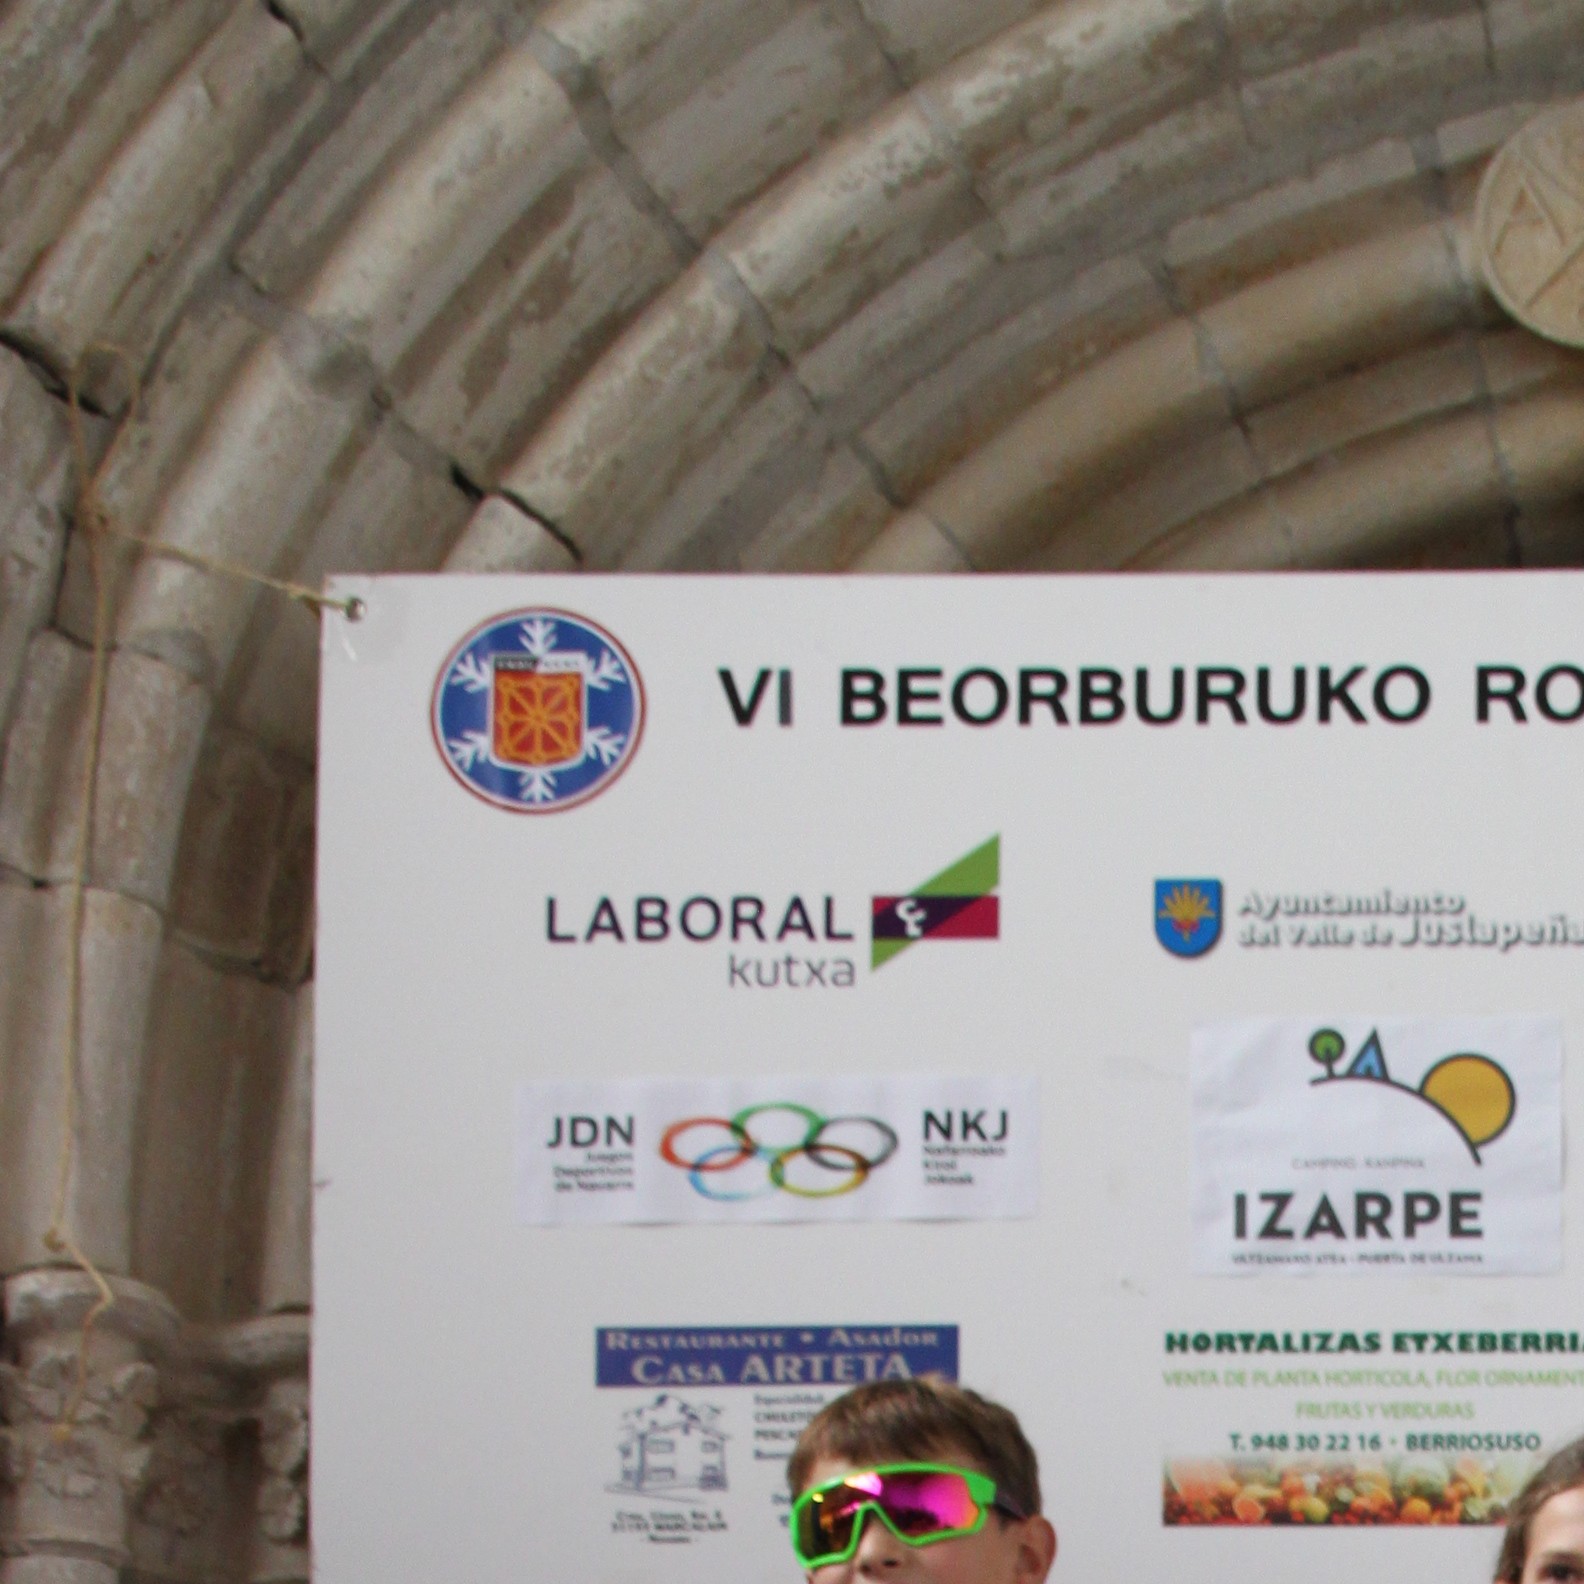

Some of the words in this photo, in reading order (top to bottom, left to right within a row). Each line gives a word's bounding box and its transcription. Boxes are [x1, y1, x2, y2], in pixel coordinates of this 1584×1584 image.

[718, 668, 794, 727] VI
[840, 666, 1432, 727] BEORBURUKO
[547, 896, 855, 942] LABORAL
[1238, 889, 1467, 920] Ayuntamiento
[1361, 922, 1393, 946] de
[728, 953, 856, 988] kutxa
[547, 1115, 635, 1148] JDN
[923, 1108, 1009, 1141] NKJ
[1234, 1192, 1483, 1239] IZARPE
[1165, 1332, 1381, 1352] HORTALIZAS
[740, 1354, 913, 1382] ARTETA
[1163, 1370, 1218, 1386] VENTA
[1224, 1370, 1246, 1386] DE
[1253, 1370, 1320, 1386] PLANTA
[1436, 1370, 1479, 1386] FLOR
[1296, 1403, 1361, 1418] FRUTAS
[1366, 1403, 1376, 1418] Y
[1381, 1402, 1475, 1418] VERDURAS
[1251, 1434, 1289, 1450] 948
[1296, 1434, 1319, 1450] 30
[1327, 1434, 1350, 1450] 22
[1358, 1434, 1381, 1450] 16
[1406, 1433, 1541, 1450] BERRIOSUSO
